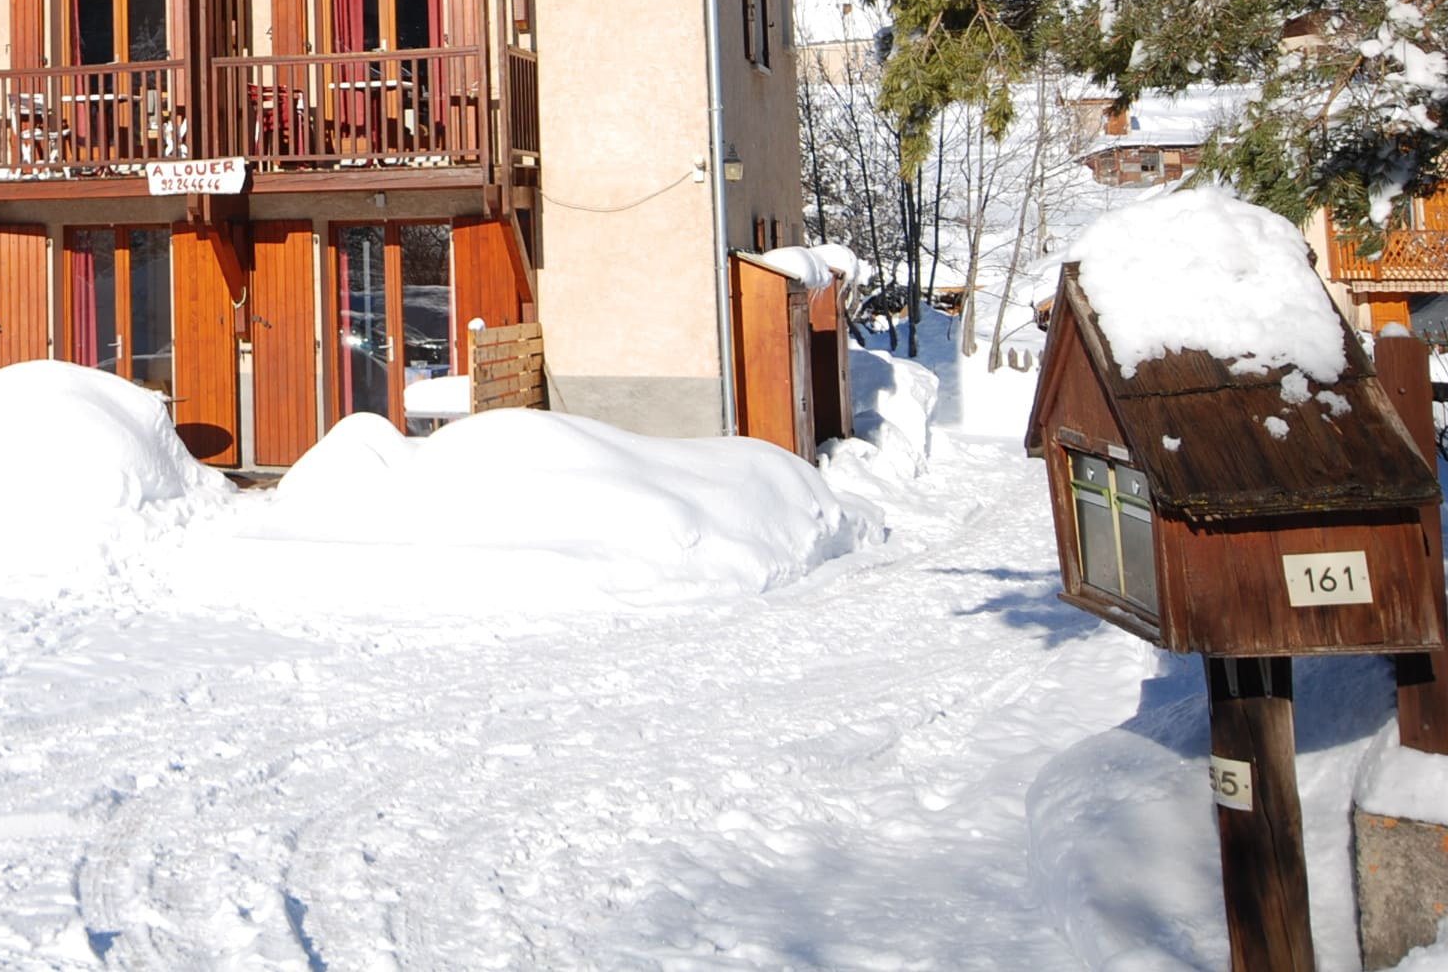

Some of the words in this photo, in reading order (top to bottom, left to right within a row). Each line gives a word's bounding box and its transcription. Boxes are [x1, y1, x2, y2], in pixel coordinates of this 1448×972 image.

[152, 164, 163, 177] A
[173, 161, 235, 177] LOUER
[1304, 566, 1354, 593] 161
